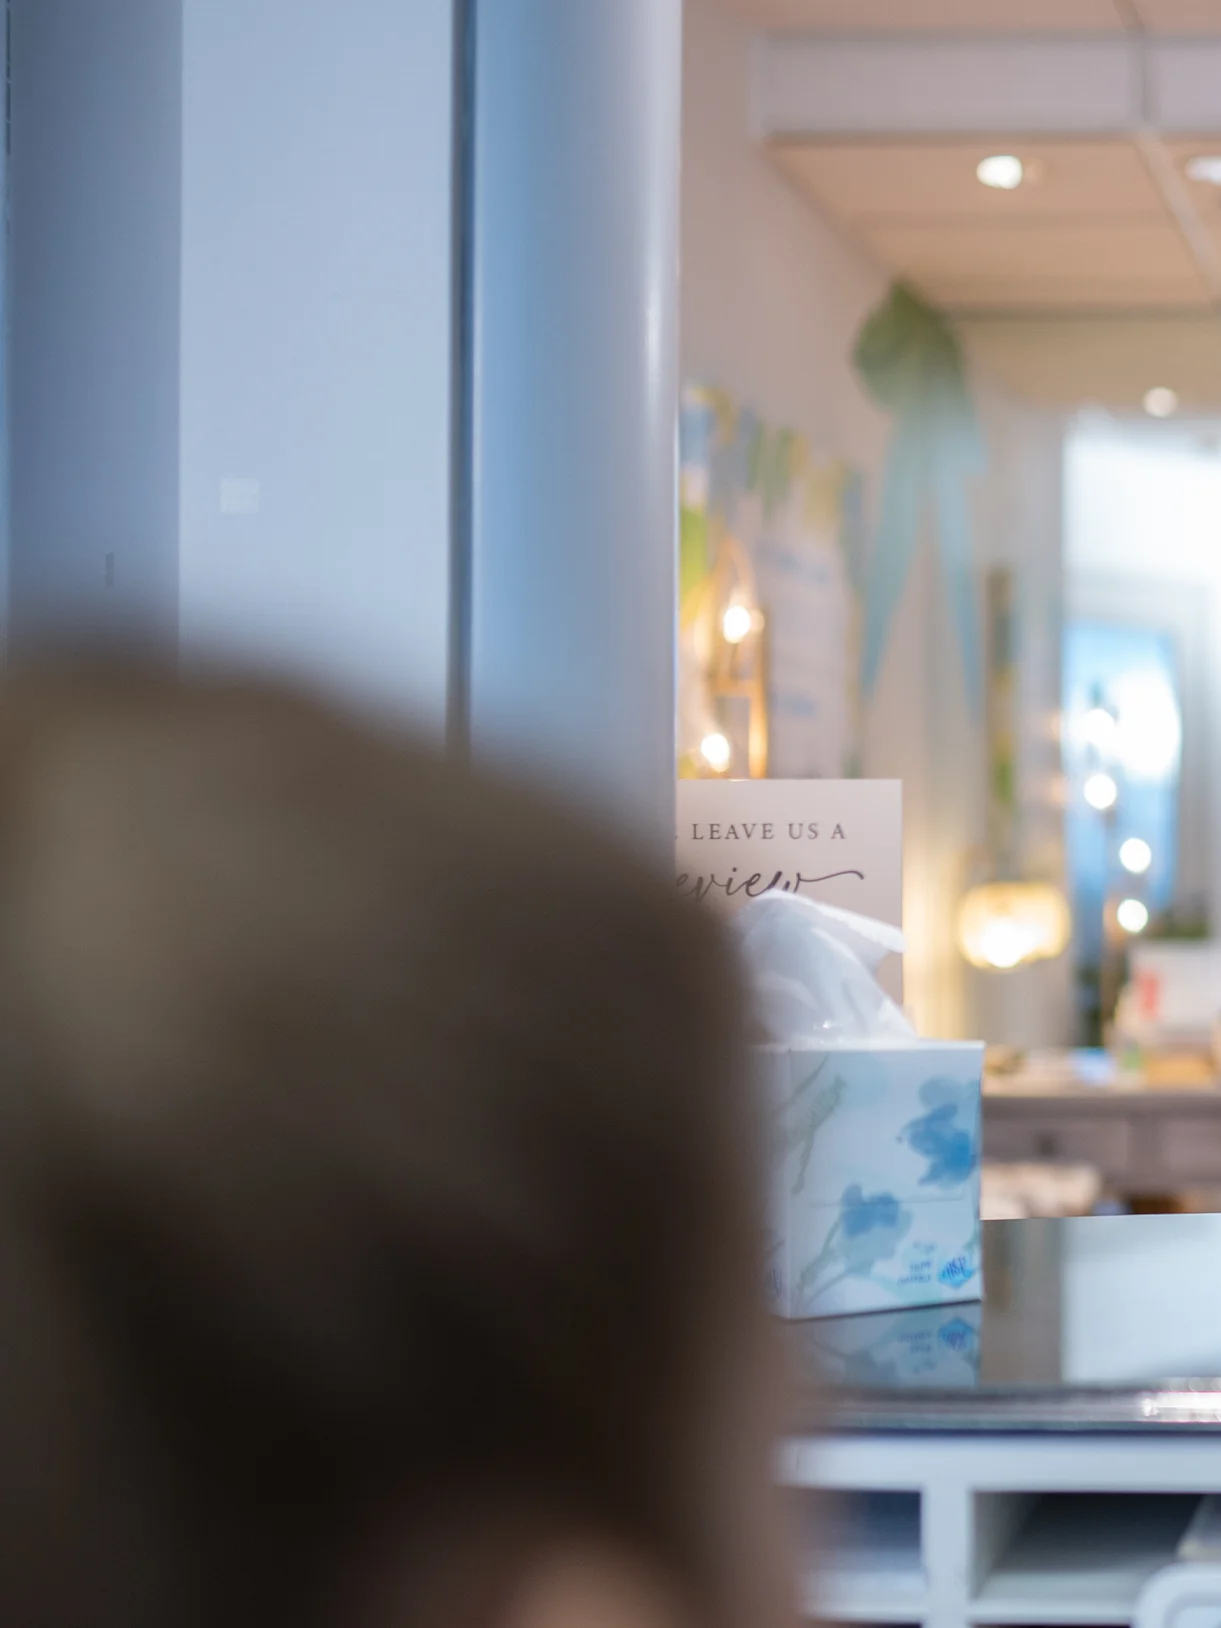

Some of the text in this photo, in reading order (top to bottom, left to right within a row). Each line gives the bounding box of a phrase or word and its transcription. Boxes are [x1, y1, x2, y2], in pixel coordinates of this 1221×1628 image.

[692, 822, 846, 840] LEAVE US A
[676, 866, 865, 900] eview
